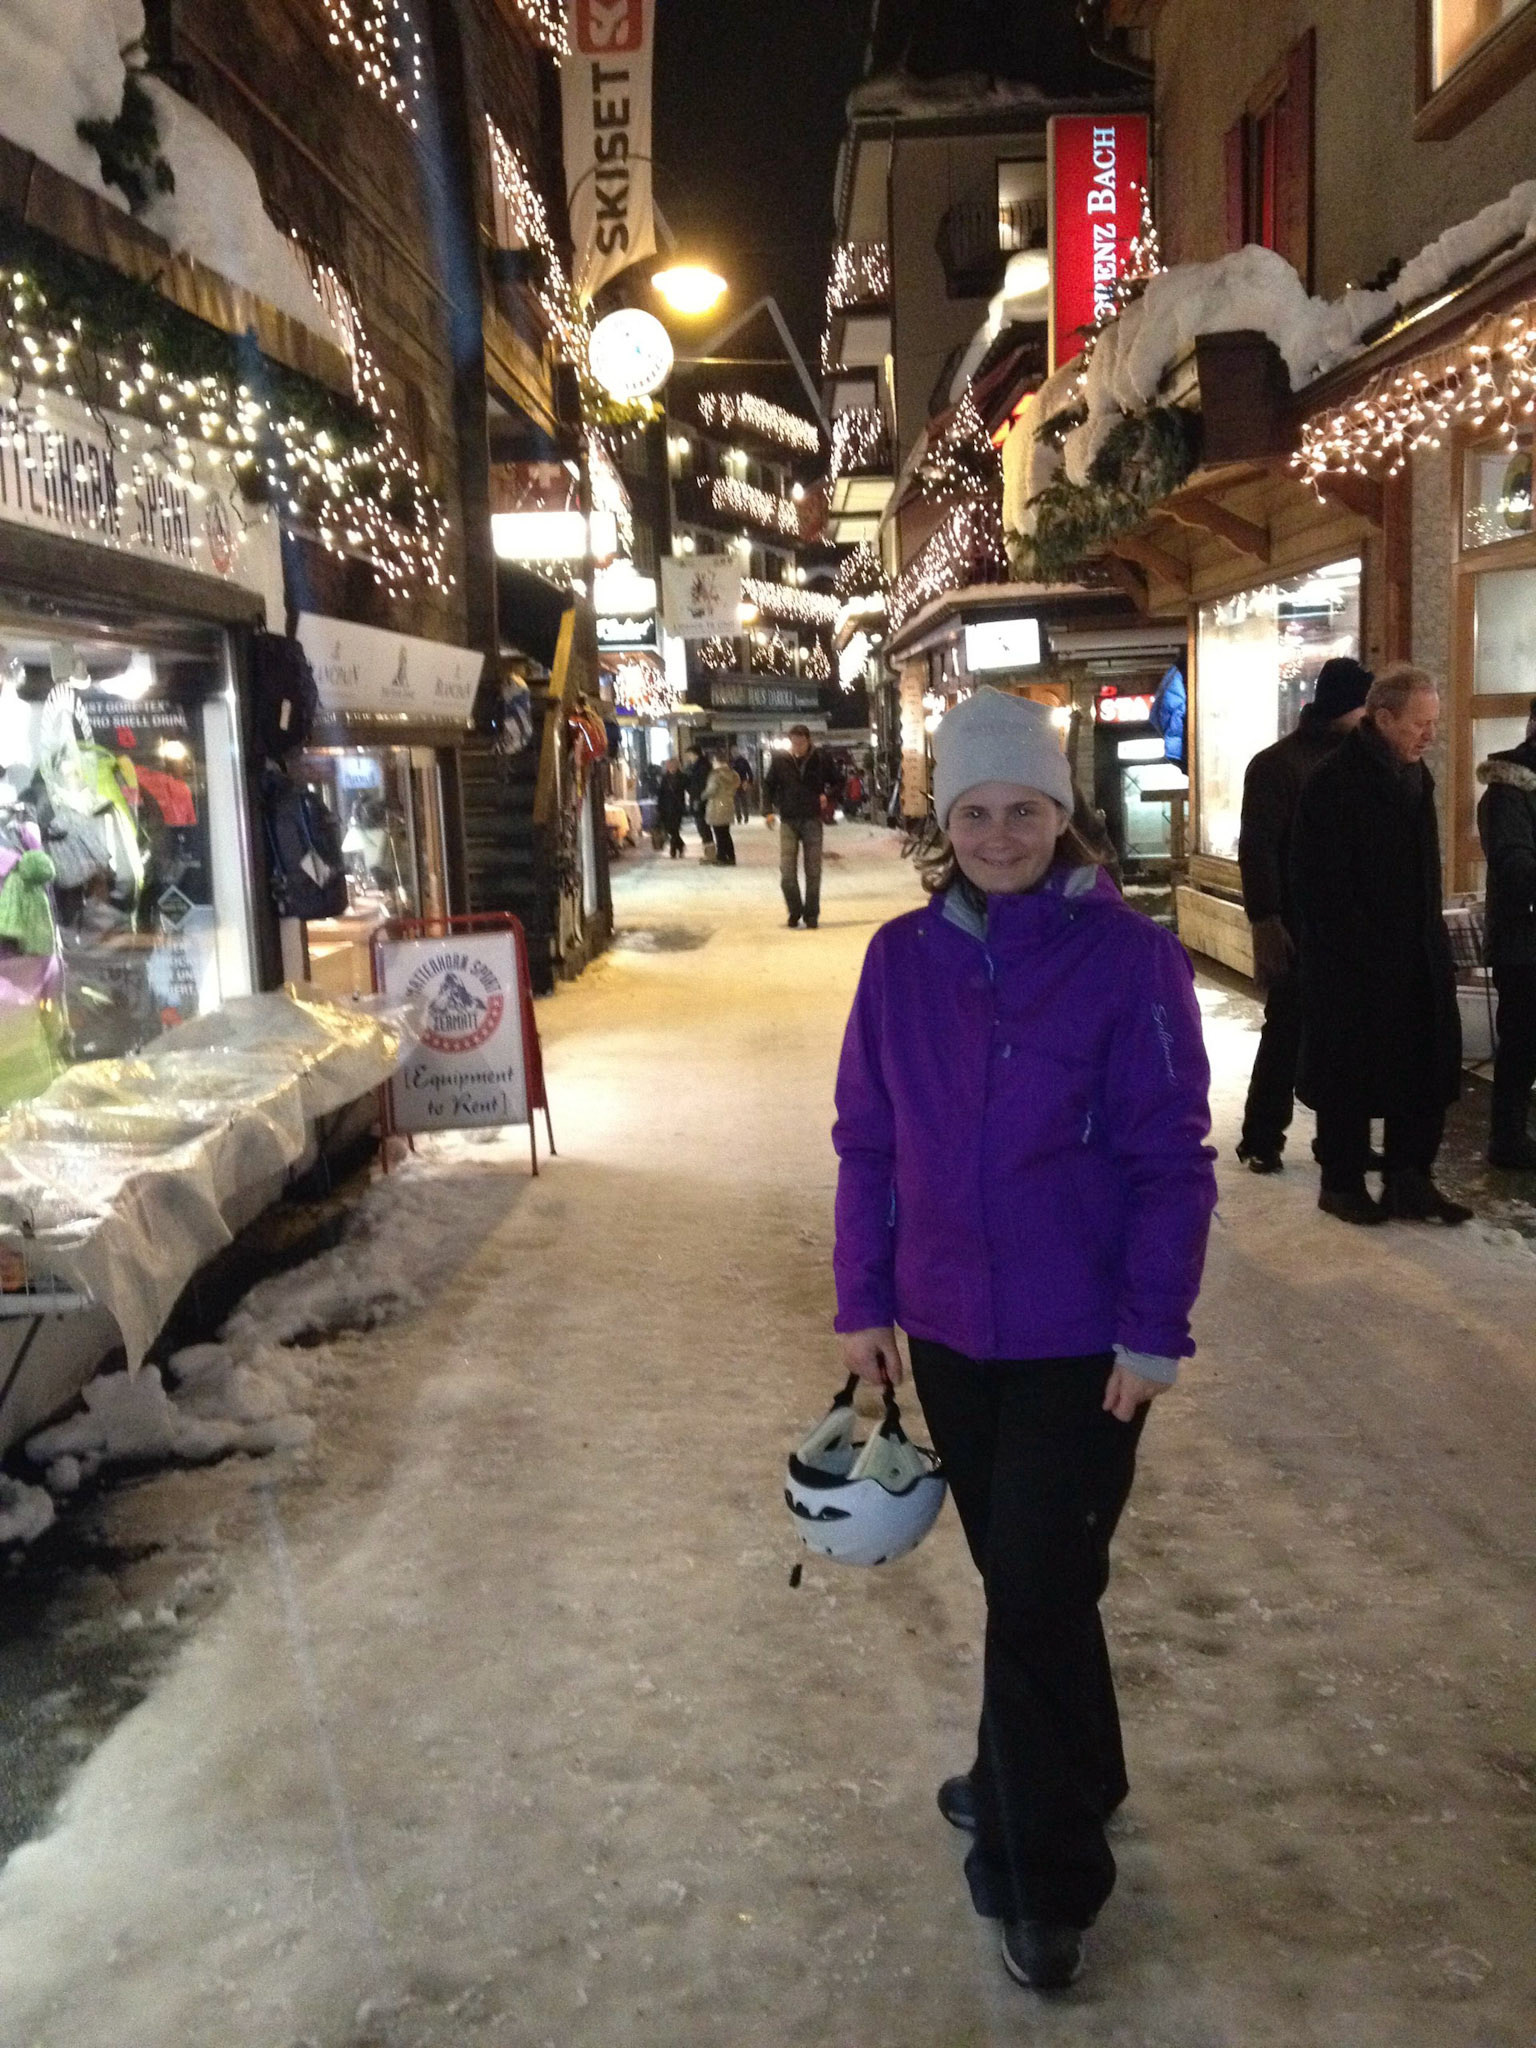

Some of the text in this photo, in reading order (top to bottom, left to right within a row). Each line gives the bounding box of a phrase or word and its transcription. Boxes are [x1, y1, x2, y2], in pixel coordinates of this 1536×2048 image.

[591, 62, 631, 256] SKISET
[1087, 125, 1117, 320] ORENZ BACH
[1100, 696, 1155, 721] STA
[427, 1099, 444, 1116] to
